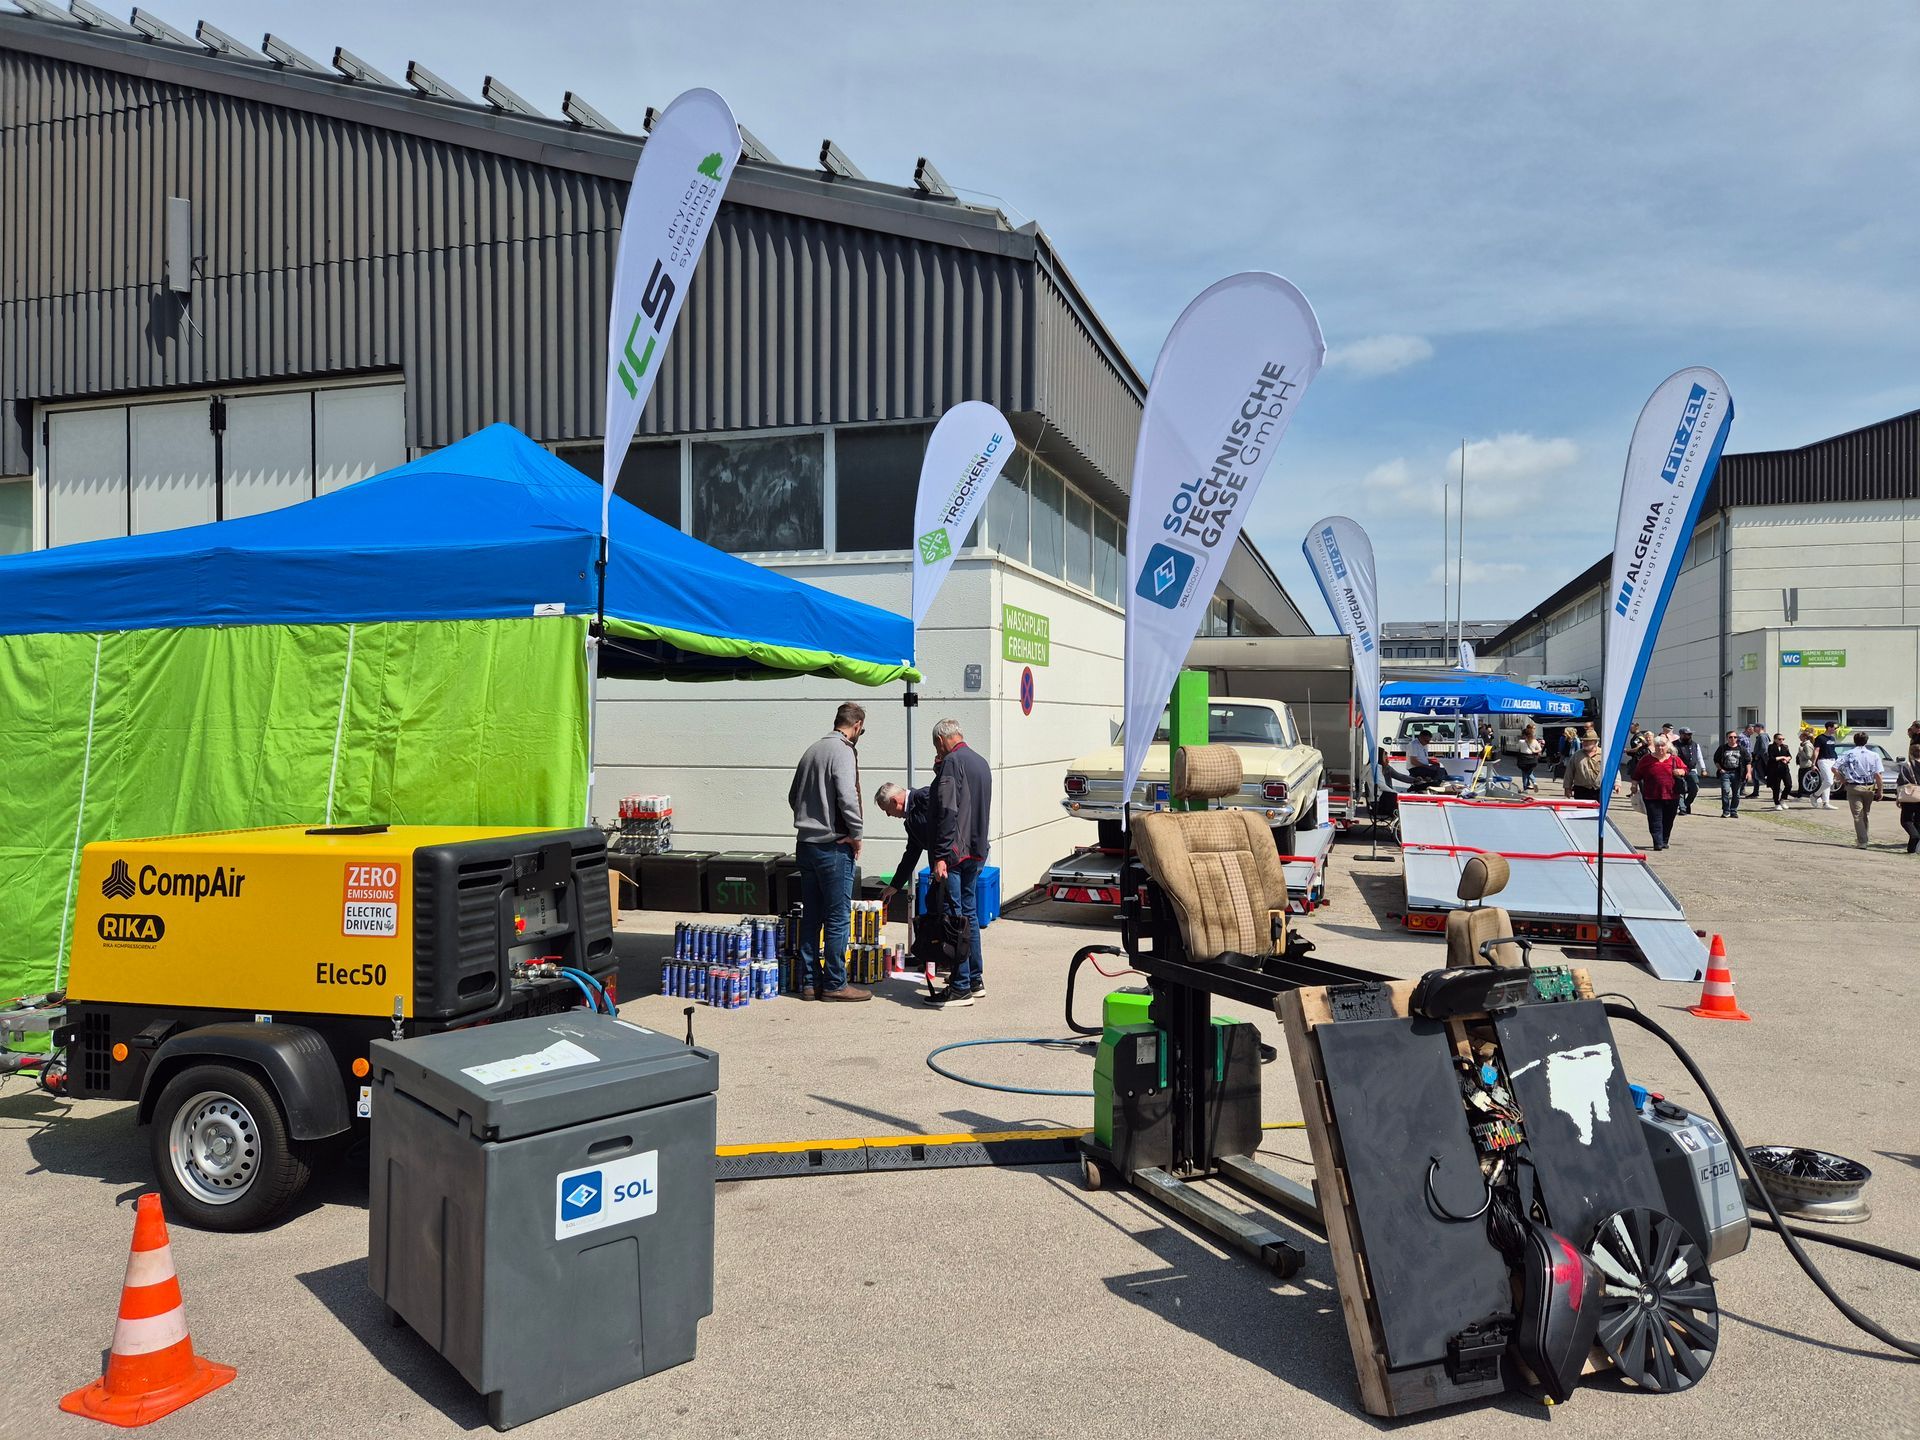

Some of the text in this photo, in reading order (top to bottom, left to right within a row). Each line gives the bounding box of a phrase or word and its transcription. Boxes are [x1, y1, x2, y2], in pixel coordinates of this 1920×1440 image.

[671, 184, 709, 262] cleaning
[679, 187, 717, 269] systems
[617, 258, 676, 401] ICS
[1181, 361, 1286, 538] TECHNISCHE
[1664, 395, 1705, 474] FIT-ZEL
[943, 433, 1003, 525] TROCKENICE
[1201, 380, 1297, 549] GASE GmbH
[953, 485, 979, 527] REINIGUNG
[1163, 477, 1203, 534] SOL
[1629, 386, 1720, 623] Fahrzeugtransport professionell.
[926, 531, 946, 561] STR
[1626, 501, 1665, 583] ALGEMA
[1005, 608, 1048, 638] WASCHPLATZ
[1008, 636, 1047, 662] FREIHALTEN
[1783, 654, 1800, 664] WC
[1379, 696, 1461, 707] LGEMA FIT-ZEL
[1512, 699, 1573, 713] ALGEMA FIT-ZEL
[138, 864, 246, 903] CompAir
[348, 866, 397, 887] ZERO
[347, 889, 394, 899] EMISSIONS
[715, 881, 758, 906] STR
[346, 906, 392, 918] ELECTRIC
[346, 919, 383, 931] DRIVEN
[103, 916, 158, 939] RIKA
[316, 962, 387, 986] Elec50
[1700, 1161, 1730, 1182] IC-030
[613, 1179, 653, 1203] SOL
